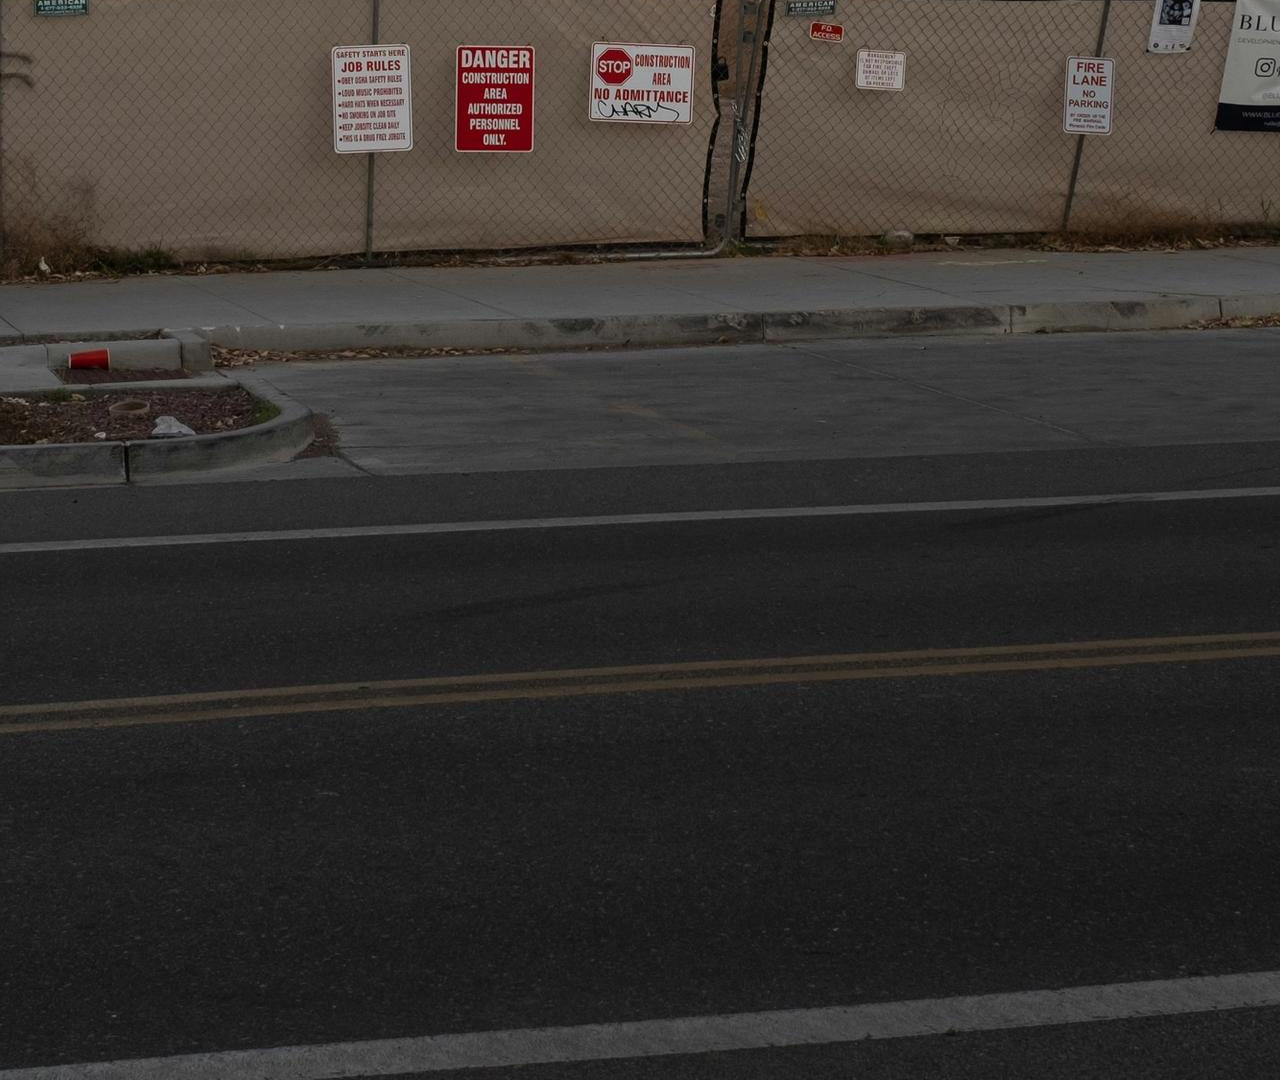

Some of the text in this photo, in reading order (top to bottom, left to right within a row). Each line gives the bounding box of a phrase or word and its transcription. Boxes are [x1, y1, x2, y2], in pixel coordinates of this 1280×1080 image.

[812, 32, 841, 40] ACCESS
[461, 50, 530, 68] DANGER
[635, 54, 690, 68] CONSTRUCTION
[342, 60, 400, 72] JOB RULES
[599, 60, 630, 74] STOP
[1077, 62, 1104, 73] FIRE
[462, 72, 530, 84] CONSTRUCTION
[652, 73, 670, 86] AREA
[1073, 75, 1107, 86] LANE
[484, 88, 507, 100] AREA
[594, 88, 688, 103] NO ADMITTANCE
[1082, 90, 1096, 98] NO
[468, 103, 523, 115] AUTHORIZED
[1069, 99, 1108, 109] PARKING
[470, 118, 520, 130] PERSONNEL
[482, 134, 506, 146] ONLY.
